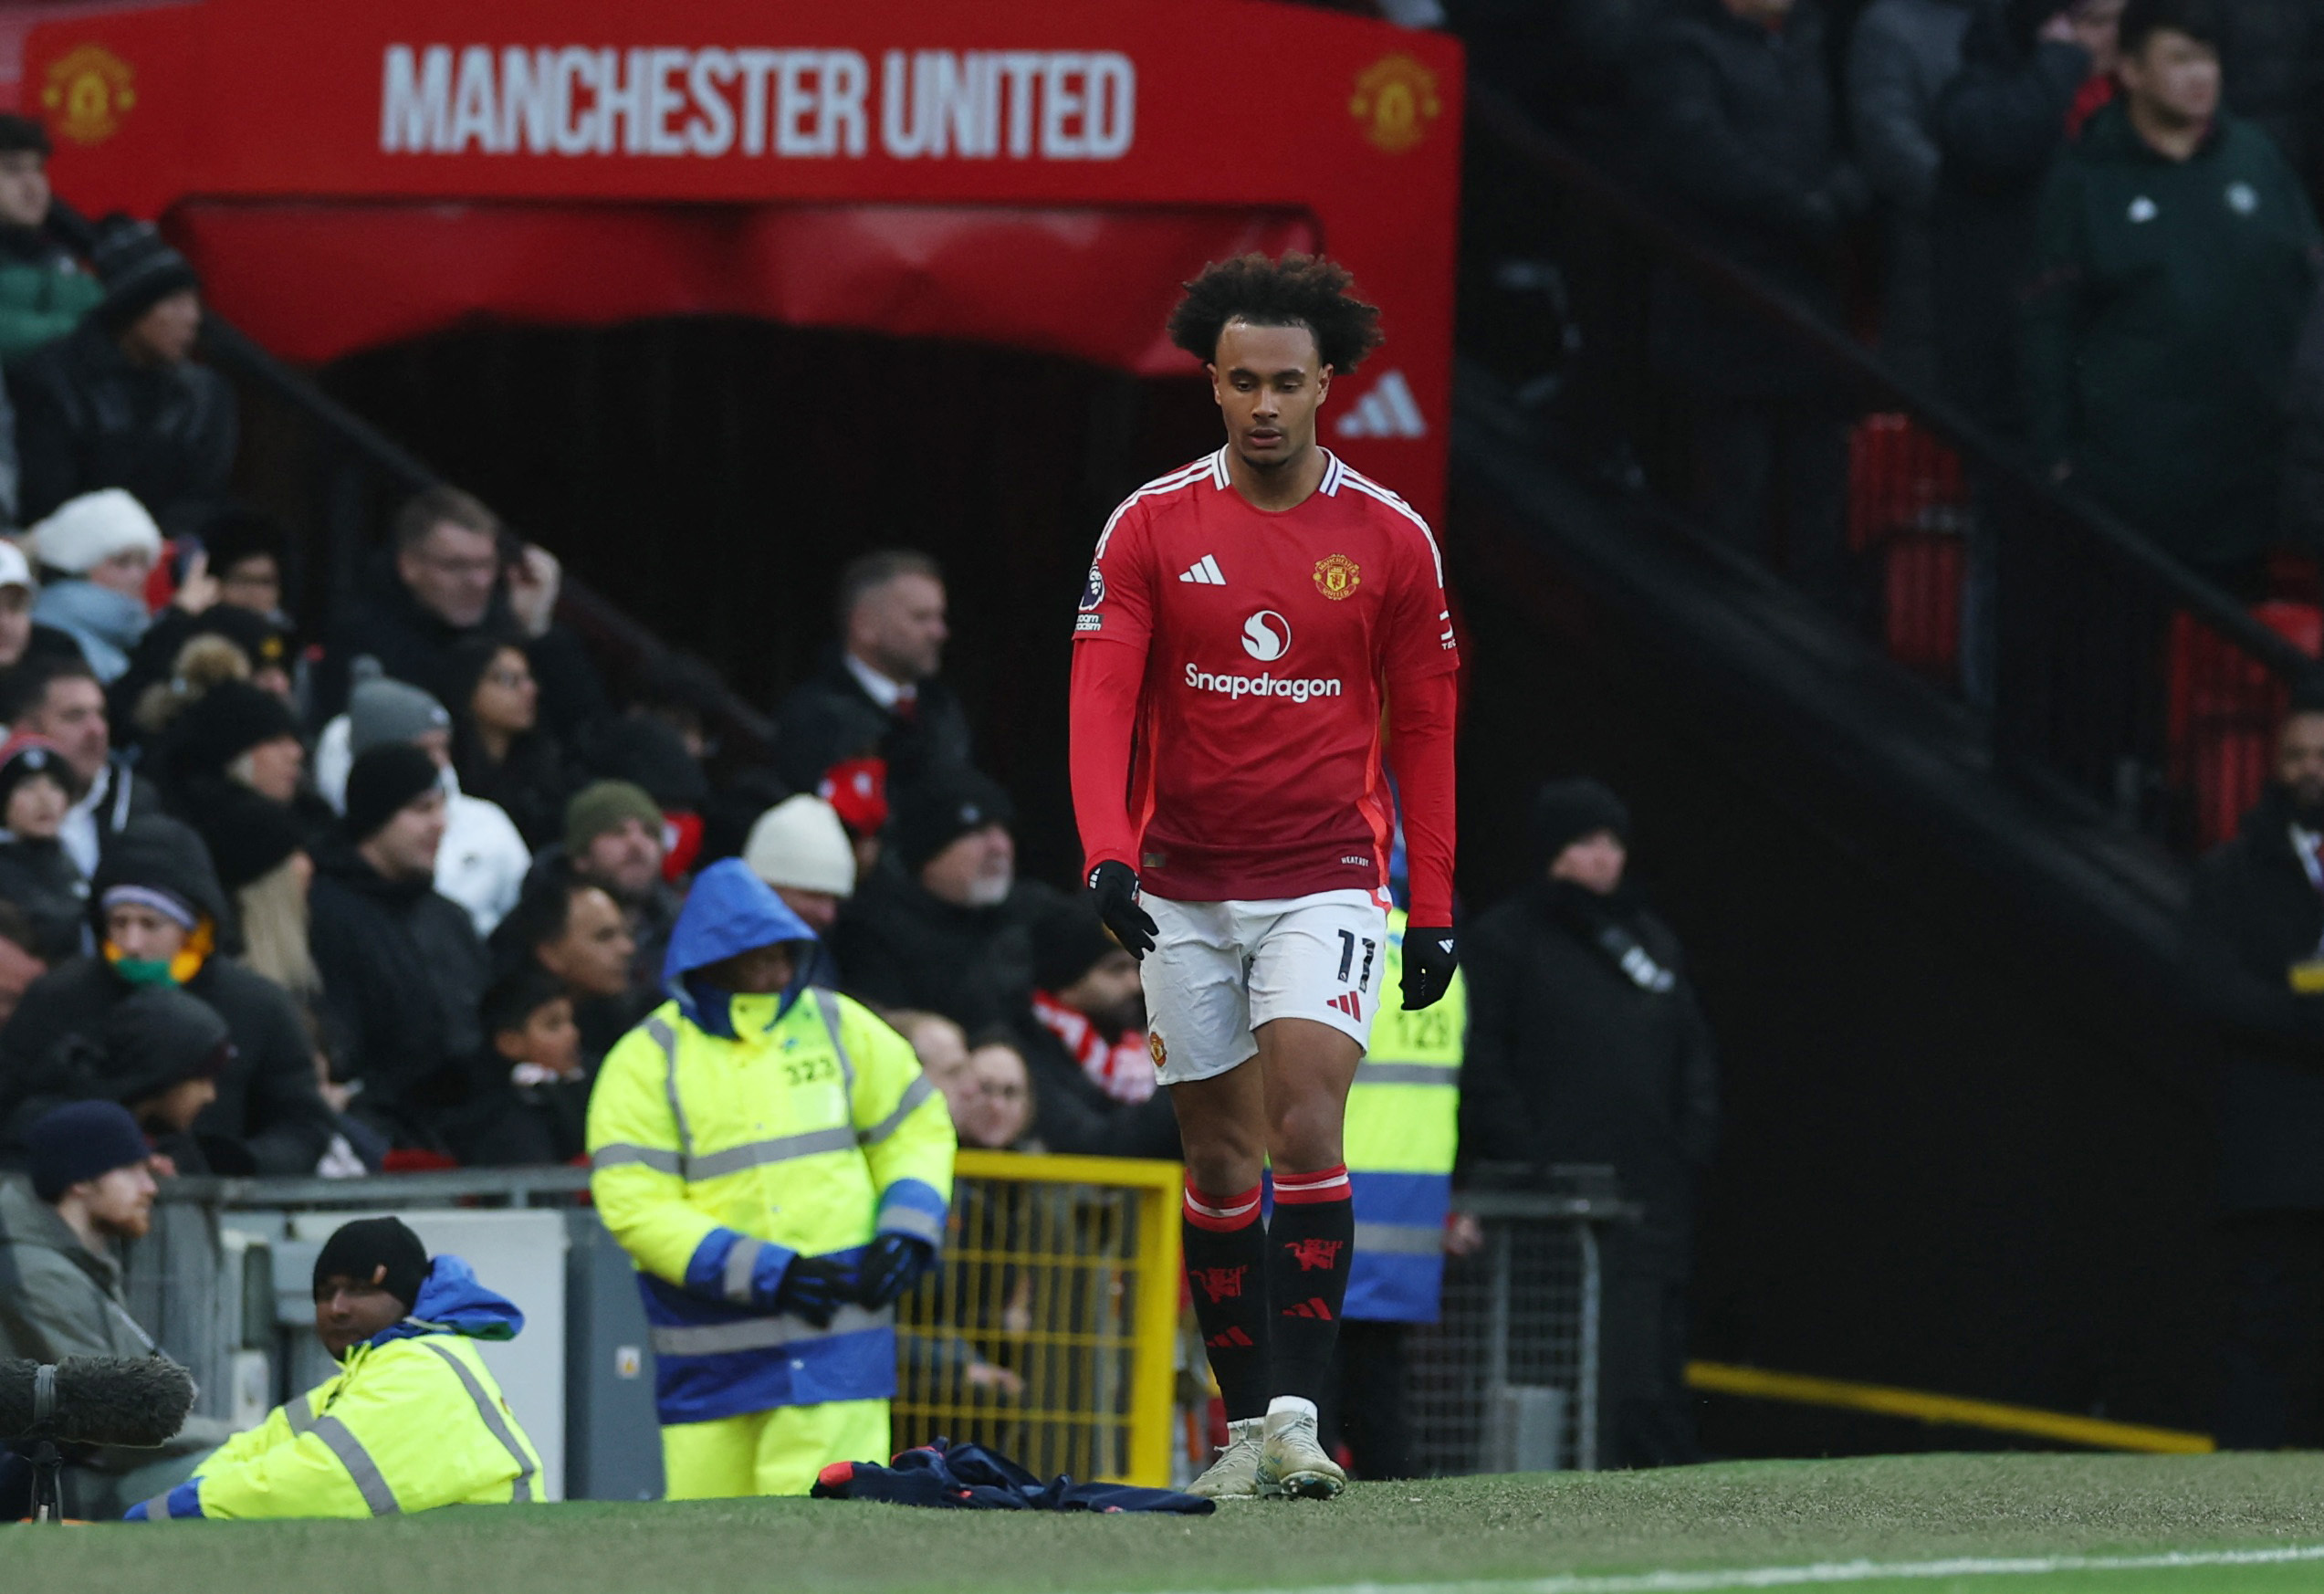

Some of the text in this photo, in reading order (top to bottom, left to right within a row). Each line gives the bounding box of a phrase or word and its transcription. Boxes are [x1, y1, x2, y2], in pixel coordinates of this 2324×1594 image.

[380, 45, 1136, 160] MANCHESTER UNITED
[1185, 662, 1341, 703] Snapdragon
[1337, 928, 1376, 993] 11
